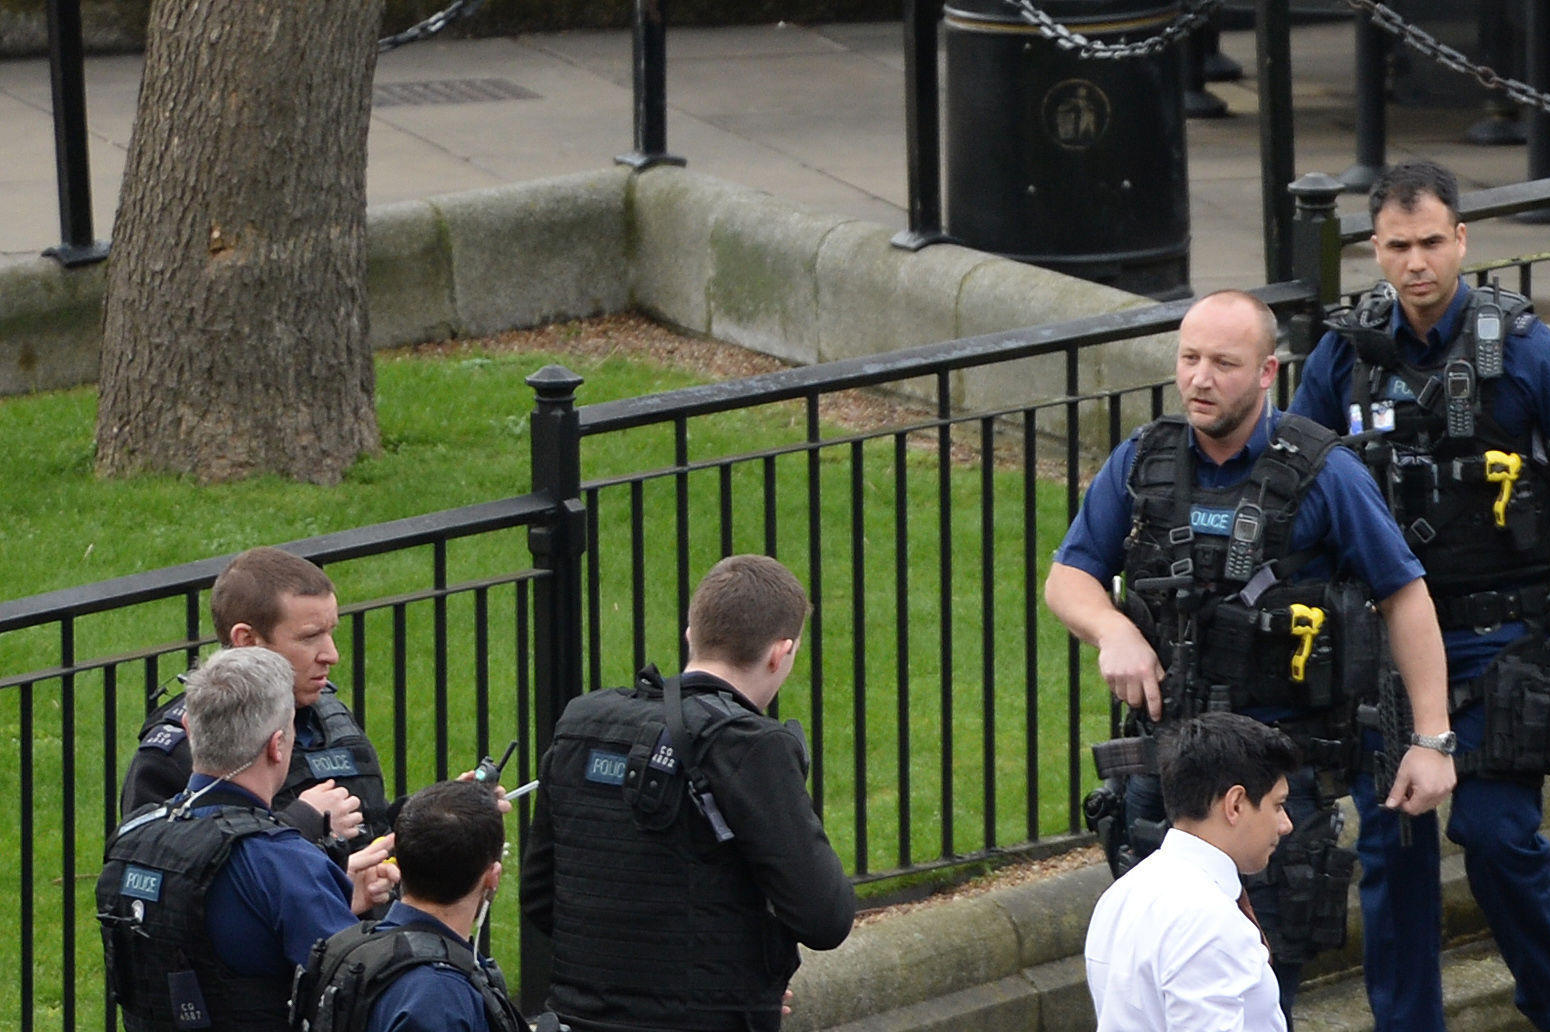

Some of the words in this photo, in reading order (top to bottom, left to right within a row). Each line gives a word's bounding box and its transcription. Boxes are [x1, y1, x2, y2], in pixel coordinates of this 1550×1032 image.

[1190, 510, 1230, 529] OLICE
[310, 754, 352, 772] POLICE
[592, 757, 627, 779] POLIC
[125, 871, 158, 894] POLICE
